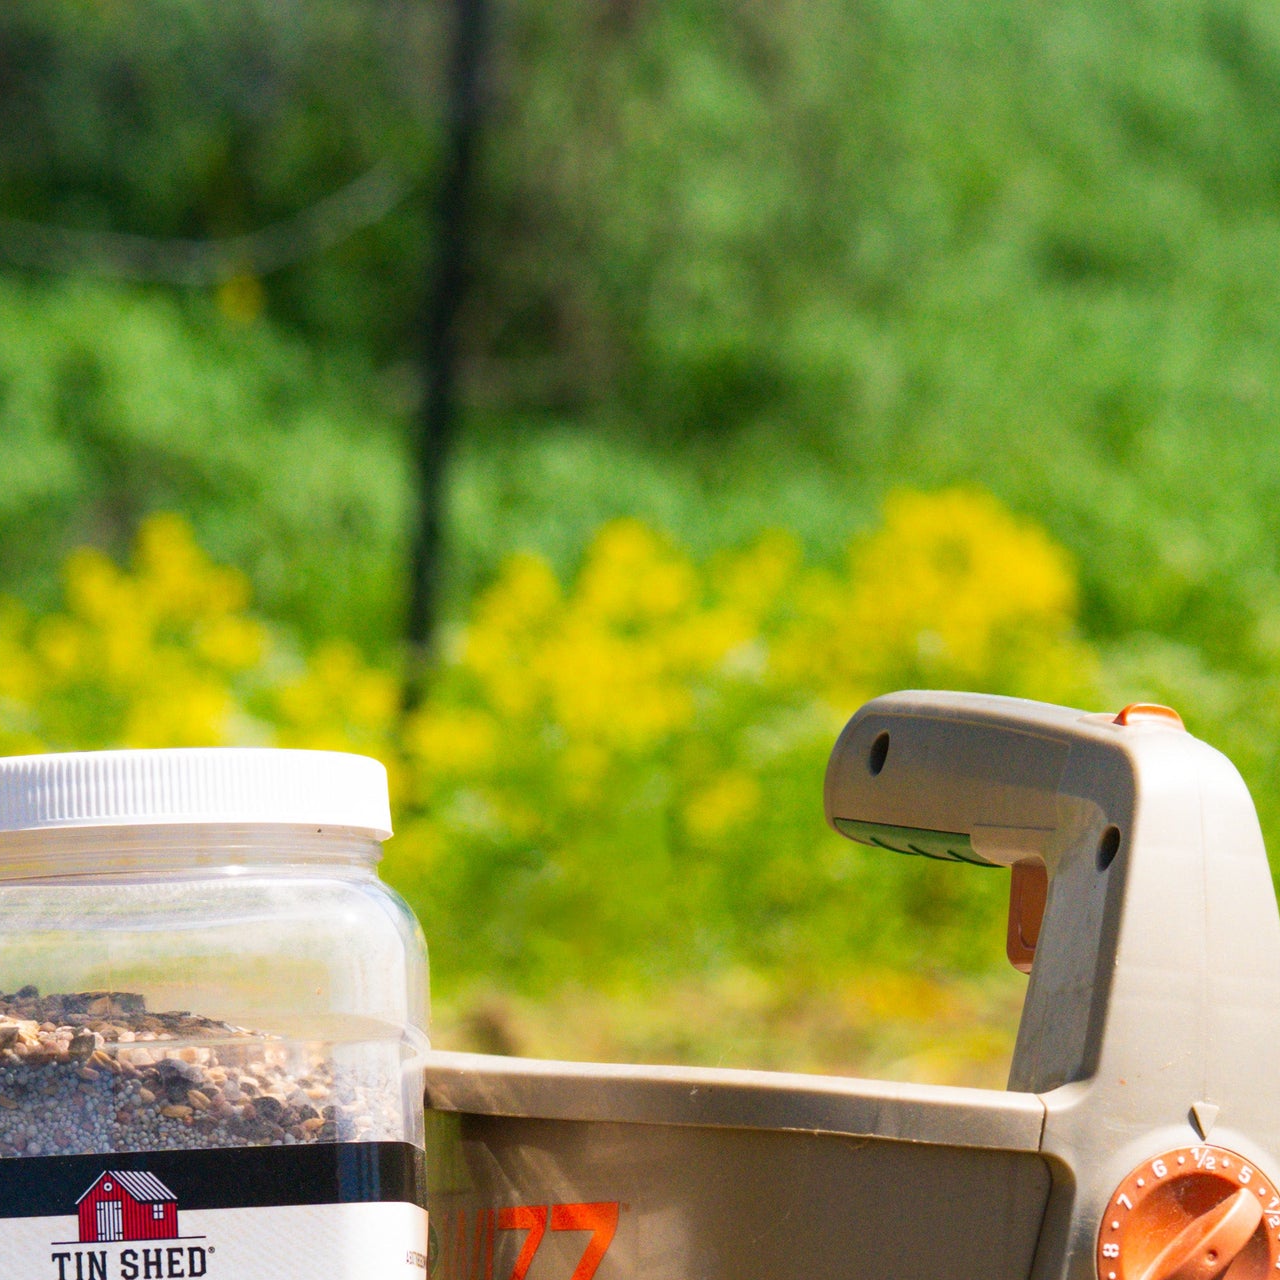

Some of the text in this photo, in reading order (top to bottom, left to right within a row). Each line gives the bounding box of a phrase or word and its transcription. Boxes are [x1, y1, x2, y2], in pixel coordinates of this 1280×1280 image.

[1151, 1159, 1168, 1178] 6
[1237, 1166, 1254, 1184] 5
[1116, 1193, 1133, 1210] 7
[1102, 1242, 1120, 1258] 8
